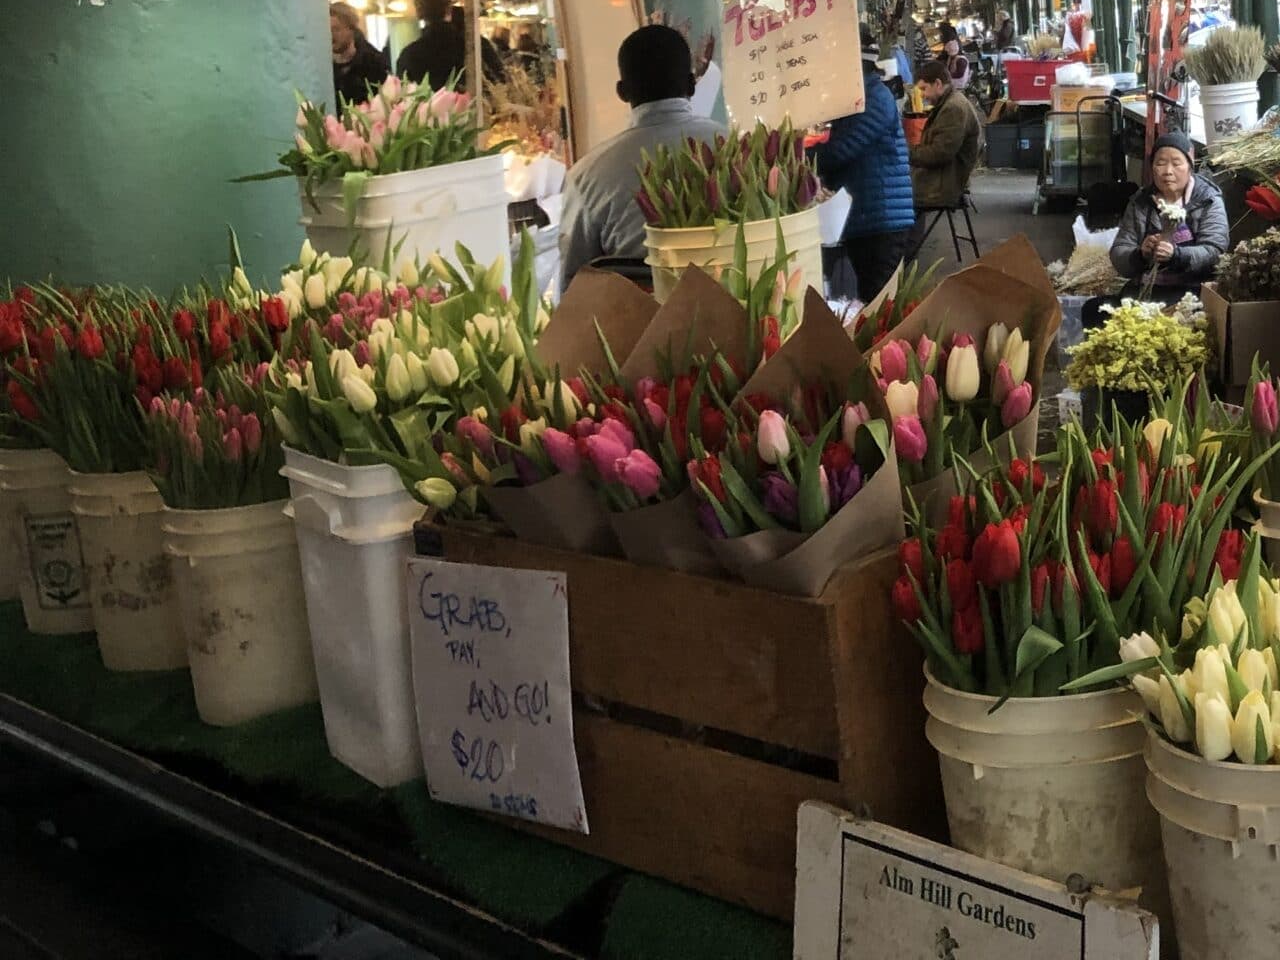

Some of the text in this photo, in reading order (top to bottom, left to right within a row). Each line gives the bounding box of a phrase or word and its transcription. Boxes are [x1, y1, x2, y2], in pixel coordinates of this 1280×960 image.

[419, 571, 512, 638] GRAB,
[445, 640, 481, 669] PAY,
[467, 679, 553, 725] AND GO!
[451, 728, 505, 783] $20
[878, 864, 1038, 941] Alm Hill Gardens
